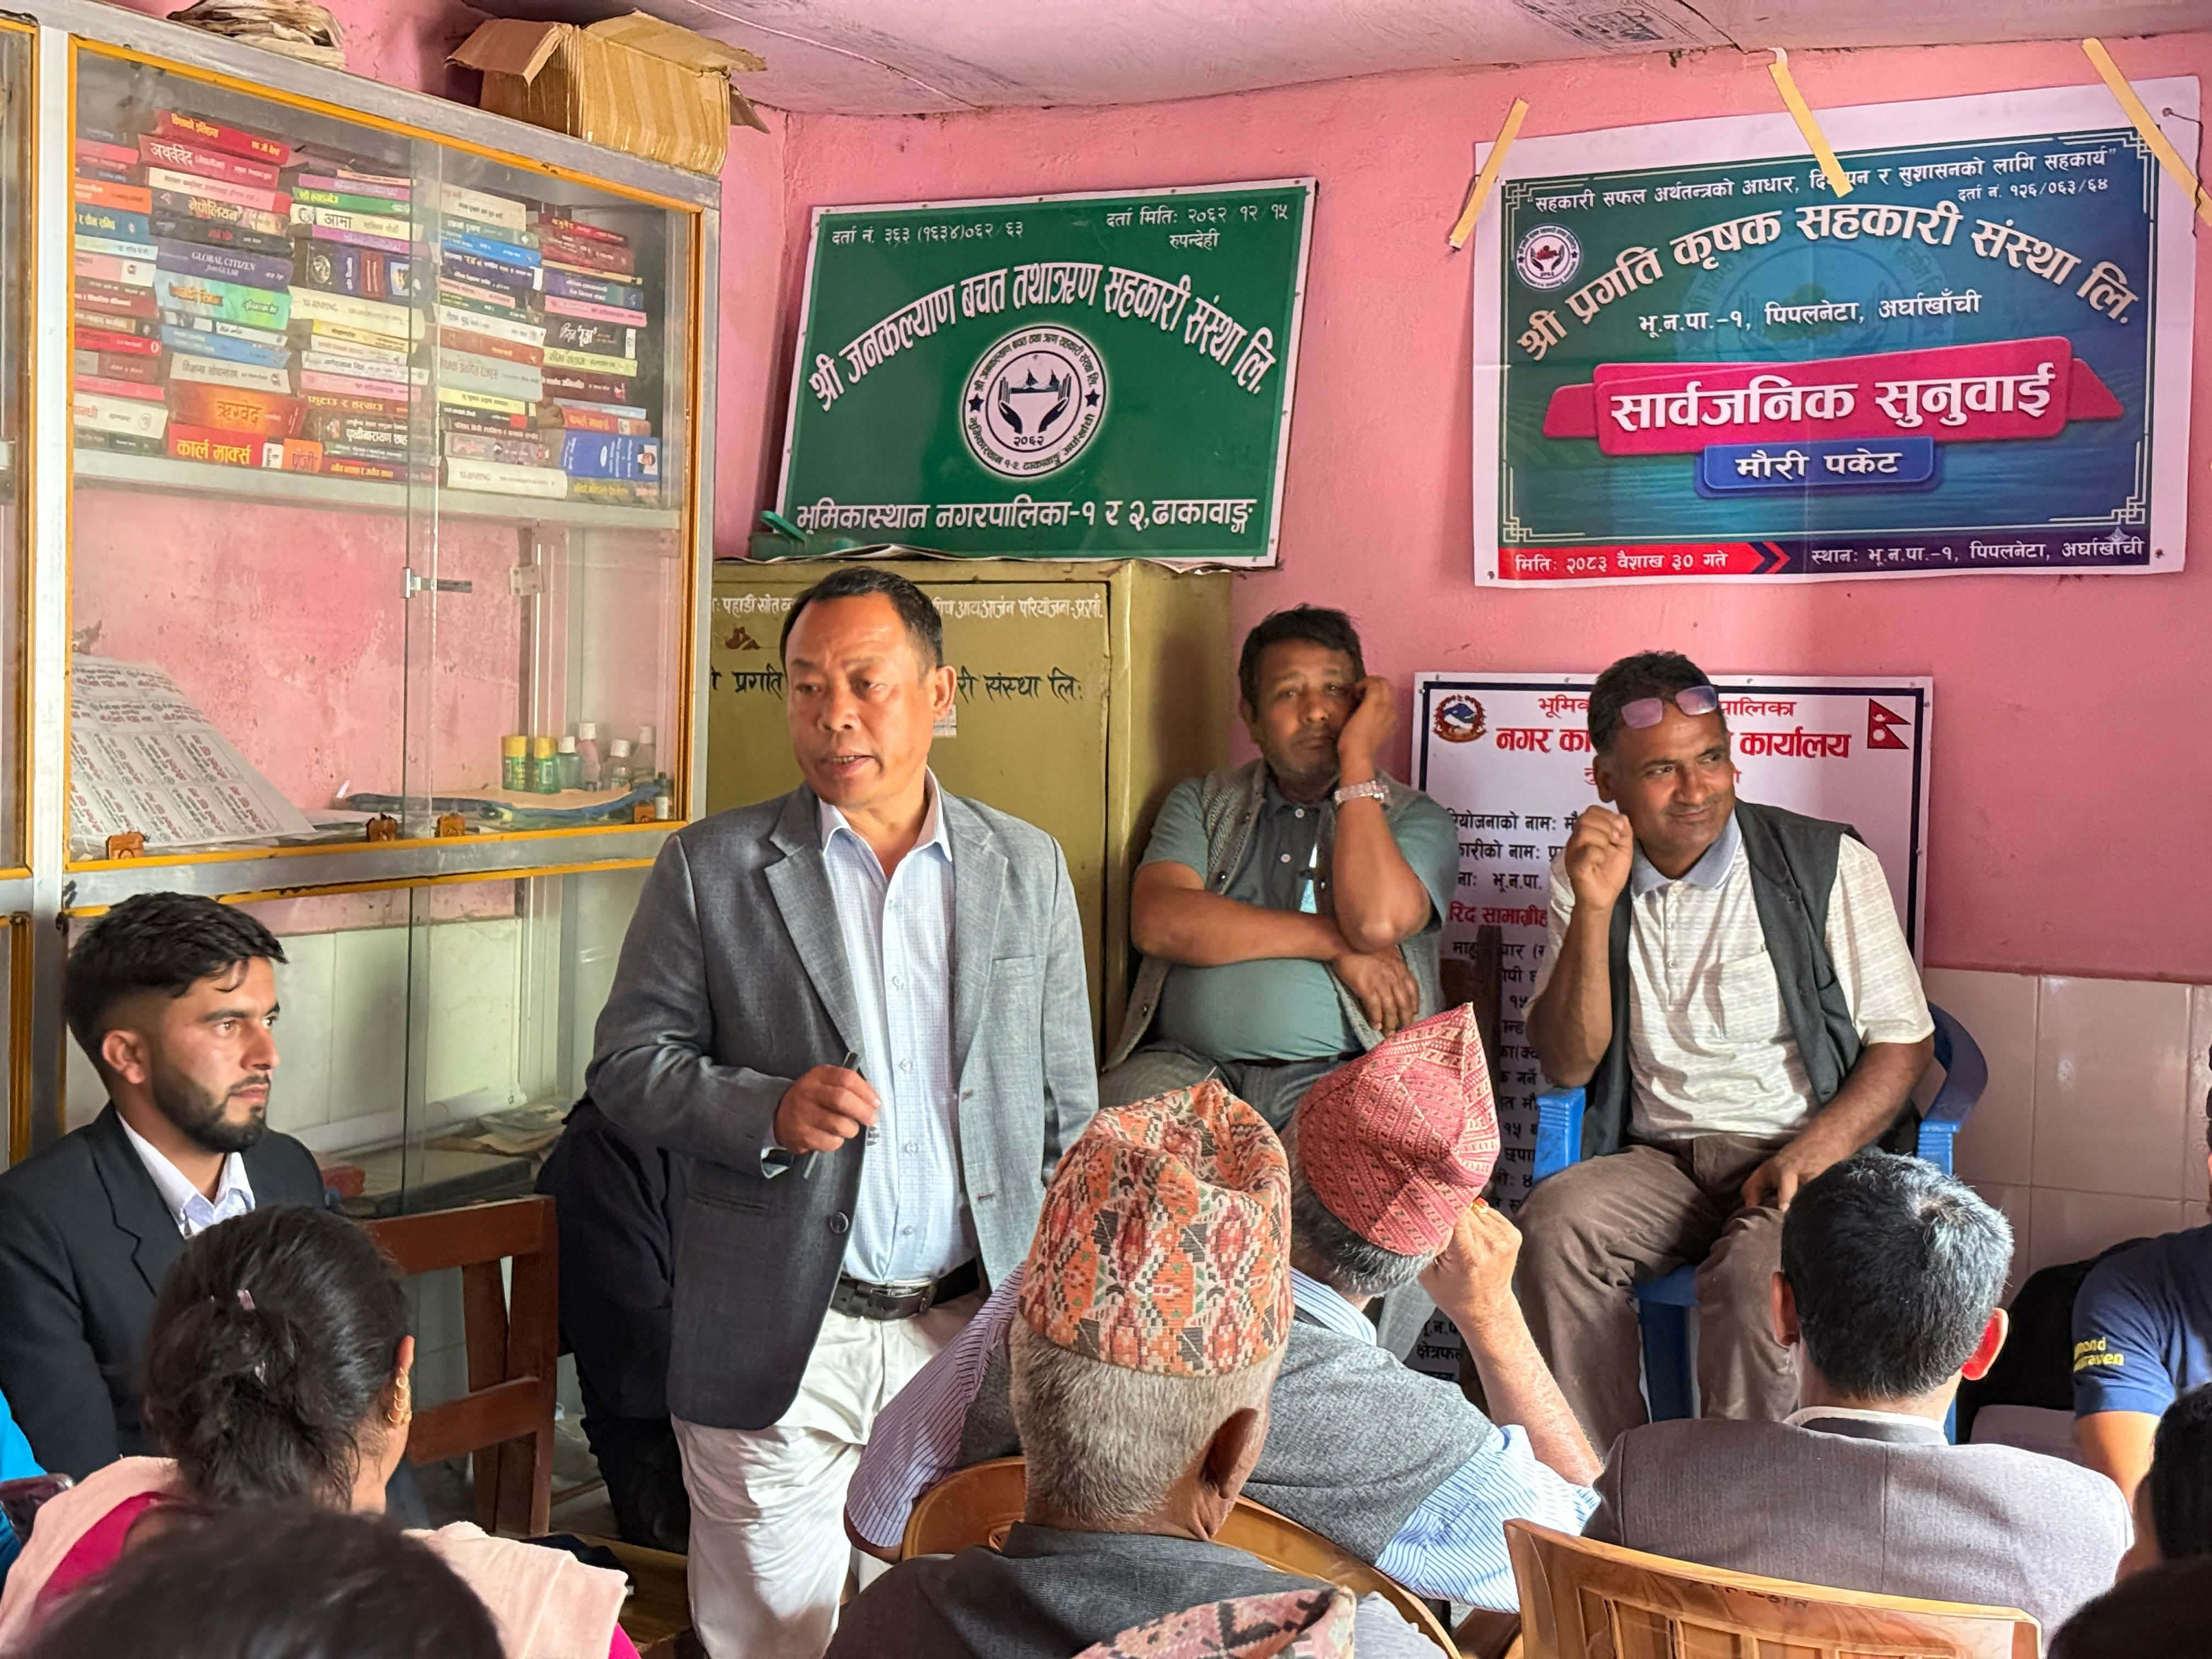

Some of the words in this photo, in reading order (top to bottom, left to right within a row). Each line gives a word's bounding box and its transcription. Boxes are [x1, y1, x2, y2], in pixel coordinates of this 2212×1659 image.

[1602, 189, 1647, 208] सफल
[1654, 180, 1735, 204] अर्थतन्त्रको
[1742, 175, 1799, 197] आधार,
[1878, 167, 1892, 185] र
[1899, 157, 1985, 188] सुशासनको
[1993, 151, 2036, 174] लागि
[1958, 183, 1982, 202] दर्ता
[2010, 178, 2108, 199] १२६/०६३/६४
[324, 213, 352, 229] आमा
[1106, 207, 1132, 227] दर्ता
[832, 225, 856, 245] दर्ता
[1169, 228, 1221, 250] रुपन्देही
[192, 251, 224, 266] GLOBAL
[224, 258, 257, 272] CITIZEN
[1518, 308, 1567, 361] श्री
[1566, 246, 1663, 324] प्रगति
[1670, 209, 1783, 271] कृषक
[1795, 200, 1963, 247] सहकारी
[1972, 217, 2083, 286] संस्था
[1878, 289, 1983, 320] अर्घाखाँची
[809, 353, 845, 412] श्री
[838, 284, 956, 384] जनकल्याण
[960, 268, 1008, 318] बचत
[1104, 266, 1191, 331] सहकारी
[1184, 294, 1248, 368] संस्था
[1610, 373, 1859, 432] सार्वजनिक
[1875, 360, 2057, 429] सुनुवाई
[1013, 436, 1045, 447] २०६२
[1735, 450, 1811, 481] मौरी
[1824, 448, 1902, 474] पकेट
[1105, 500, 1124, 527] र
[1566, 553, 1609, 573] २०८३
[1616, 548, 1664, 571] वैशाख
[1669, 552, 1698, 572] ३०
[1702, 548, 1728, 569] गते
[731, 663, 784, 701] प्रगति
[1496, 728, 1551, 753] नगर
[1741, 727, 1852, 758] कार्यालय
[1447, 808, 1519, 830] रियोजनाको
[1448, 901, 1476, 923] रिद
[1504, 1122, 1520, 1138] १५
